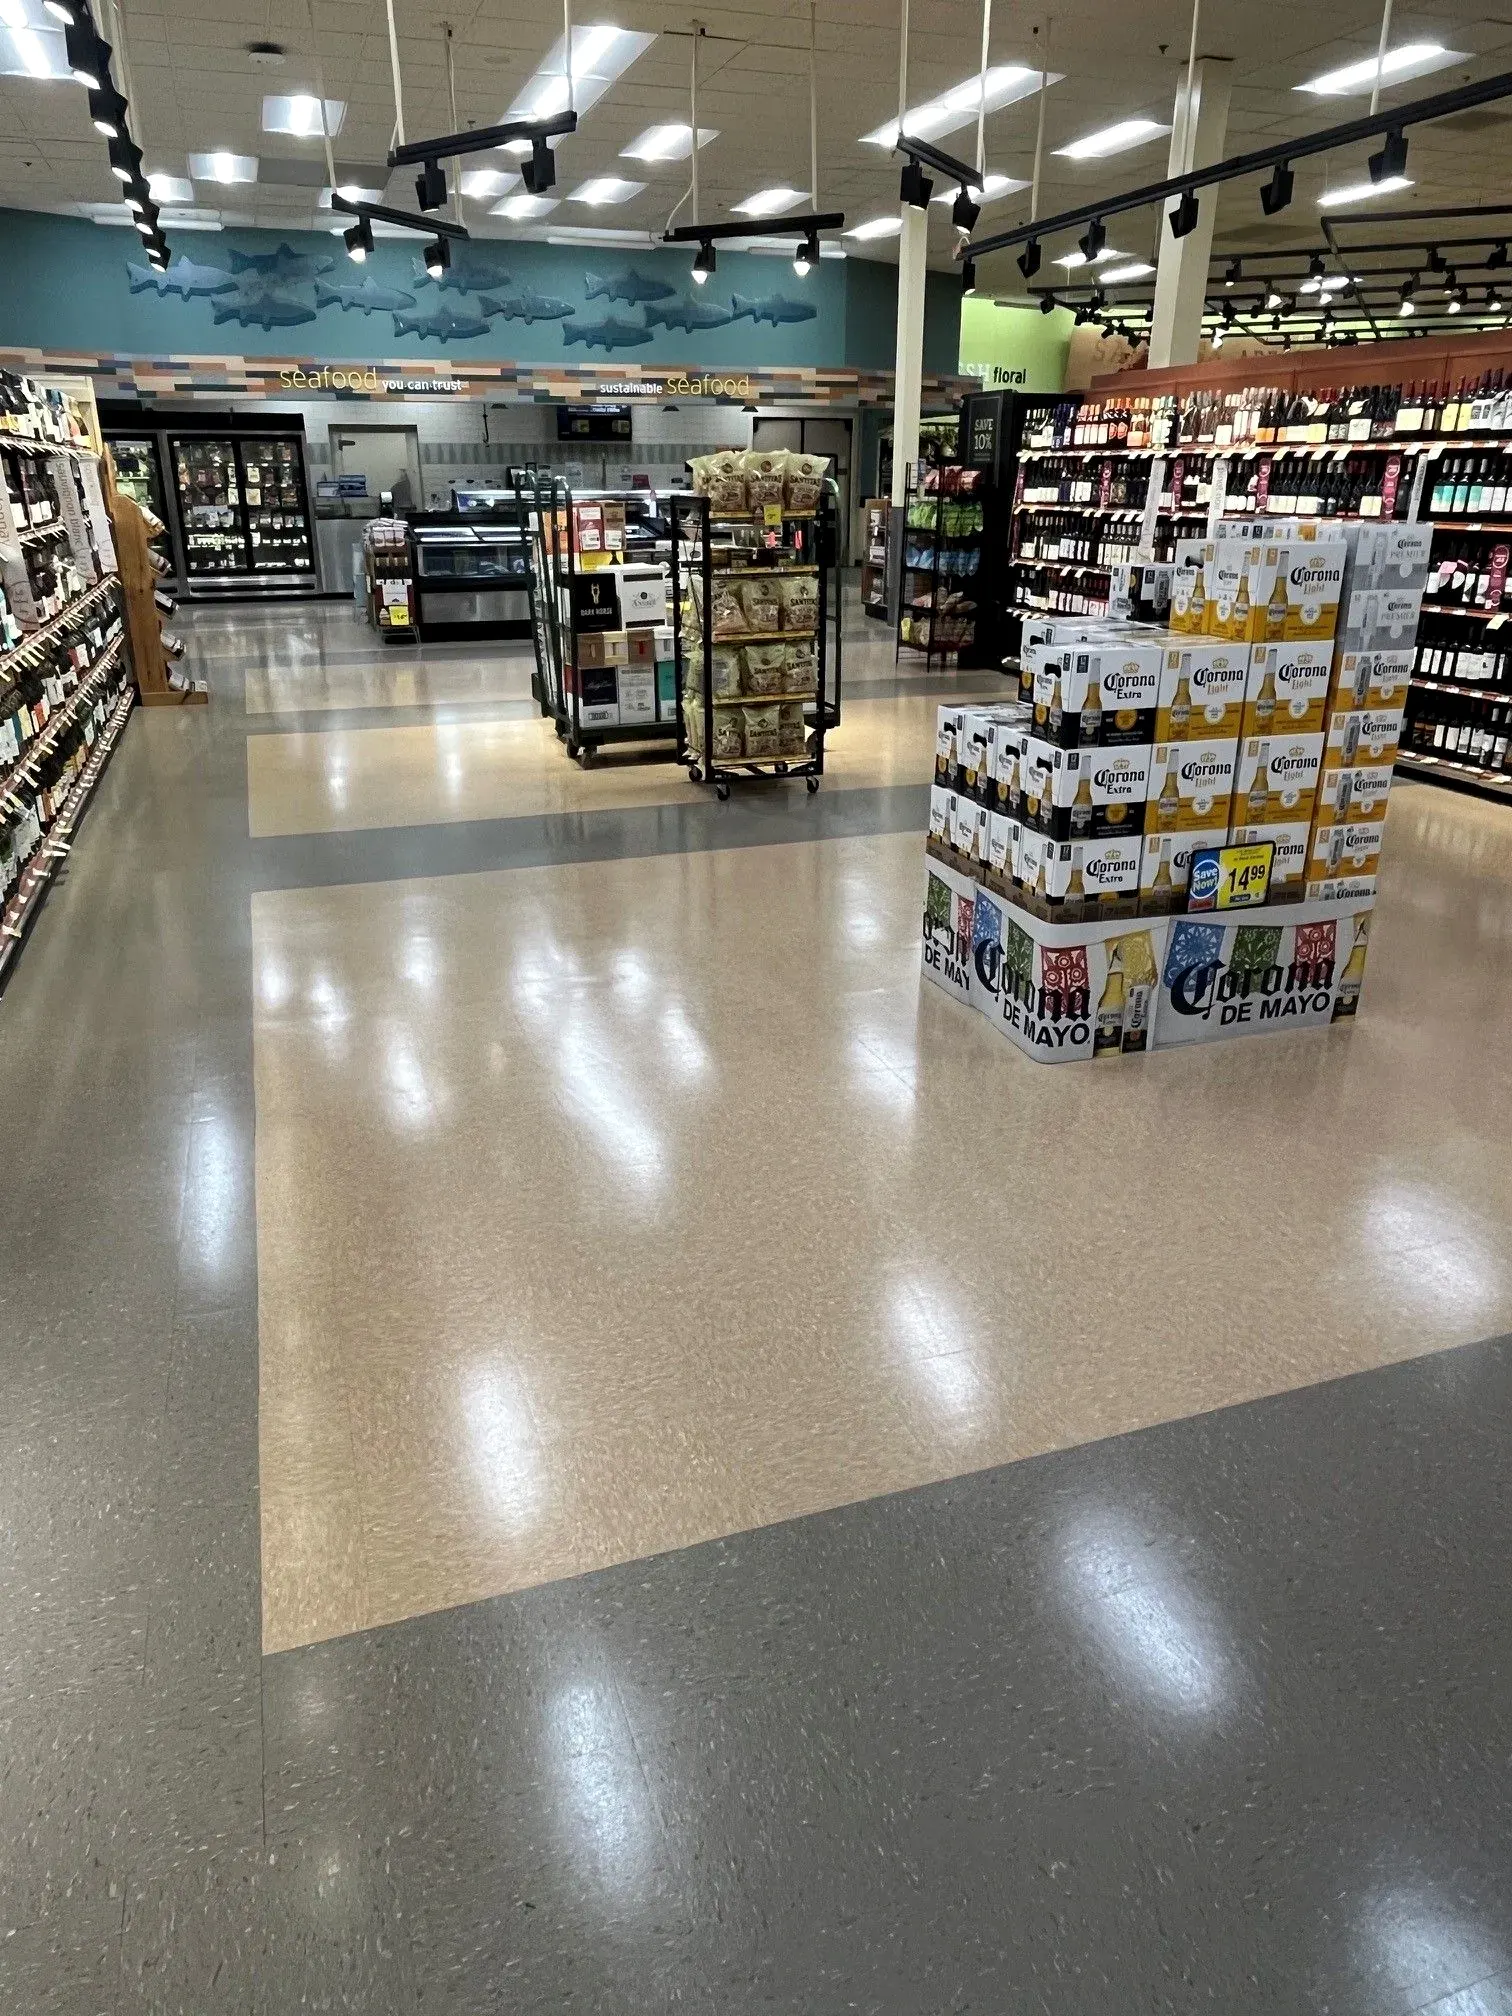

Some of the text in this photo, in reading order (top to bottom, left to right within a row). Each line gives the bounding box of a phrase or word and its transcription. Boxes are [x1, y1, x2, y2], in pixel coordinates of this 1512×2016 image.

[280, 365, 462, 395] seafood you can trust
[600, 373, 750, 396] sustainable seafood
[993, 366, 1027, 384] floral
[1290, 567, 1340, 587] Corona
[1193, 667, 1244, 688] Corona
[1278, 663, 1327, 683] Corona
[1373, 661, 1409, 676] Corona
[1104, 672, 1155, 693] Corona
[1117, 688, 1142, 700] Extra
[1361, 721, 1398, 735] Corona
[1181, 761, 1232, 782] Corona
[1270, 756, 1318, 775] Corona
[1093, 768, 1145, 788] Corona
[1354, 779, 1388, 792] Corona
[1106, 784, 1132, 795] Extra
[1277, 844, 1304, 856] rona
[1345, 834, 1379, 847] Corona
[1085, 859, 1136, 878] Corona
[1099, 873, 1124, 884] Extra
[1193, 867, 1218, 882] Save
[1336, 887, 1371, 900] Corona
[924, 941, 941, 971] DE
[974, 937, 1092, 1024] Corona
[1170, 958, 1336, 1020] Corona
[1002, 997, 1021, 1030] DE
[1130, 990, 1143, 1029] Corona
[1220, 991, 1331, 1026] DE MAYO
